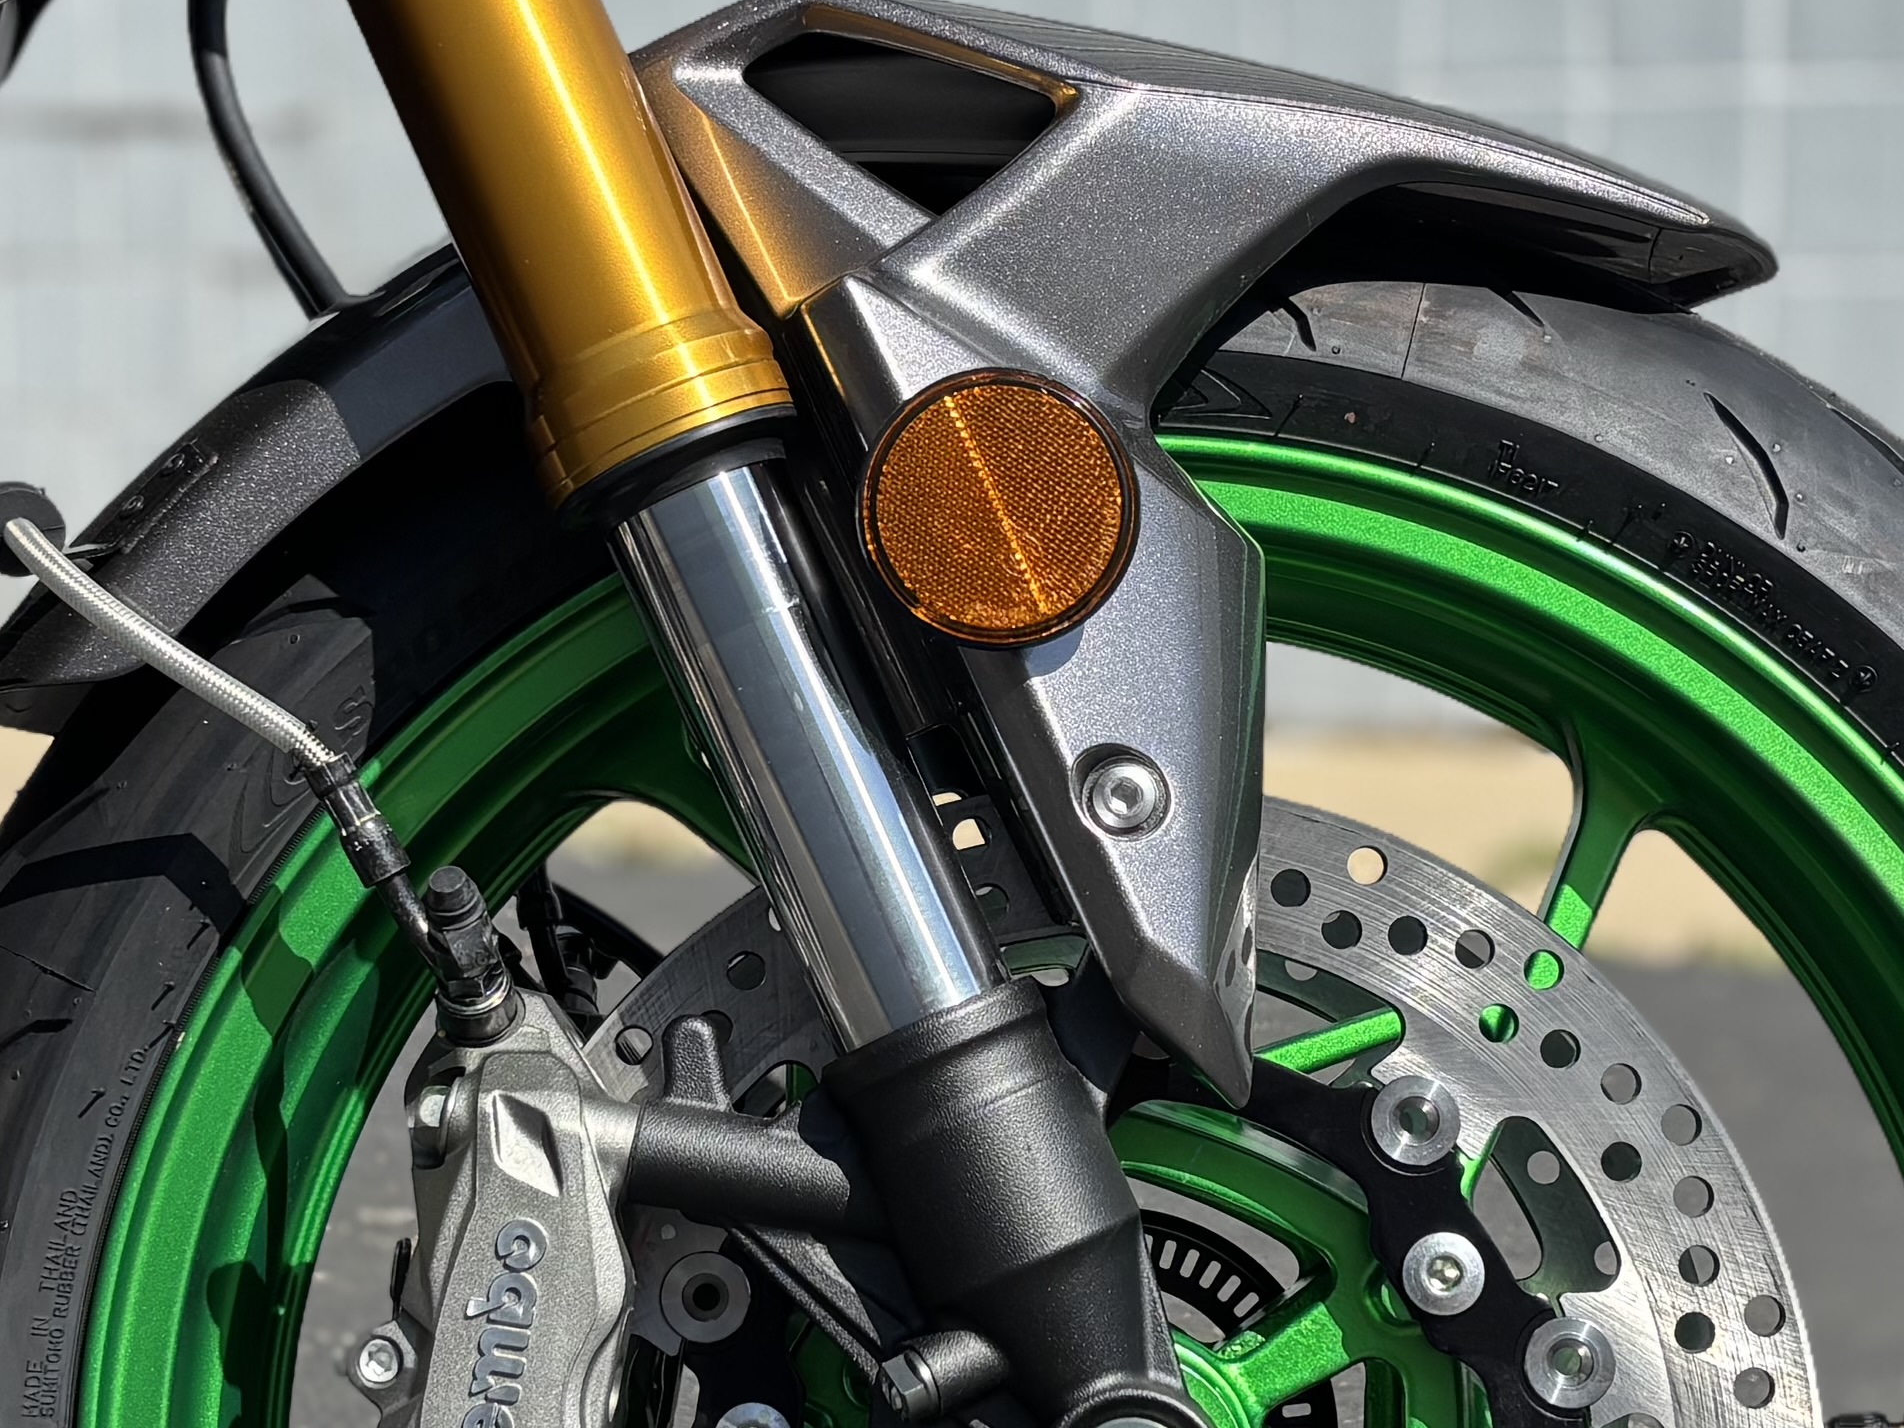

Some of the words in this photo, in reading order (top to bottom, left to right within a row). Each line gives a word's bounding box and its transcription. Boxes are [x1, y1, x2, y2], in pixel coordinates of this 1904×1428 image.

[38, 1190, 78, 1293] THAILAND
[30, 1317, 50, 1337] IN
[39, 1327, 65, 1419] SUMITOMO
[52, 1245, 82, 1318] RUBBER
[21, 1359, 44, 1418] MADE
